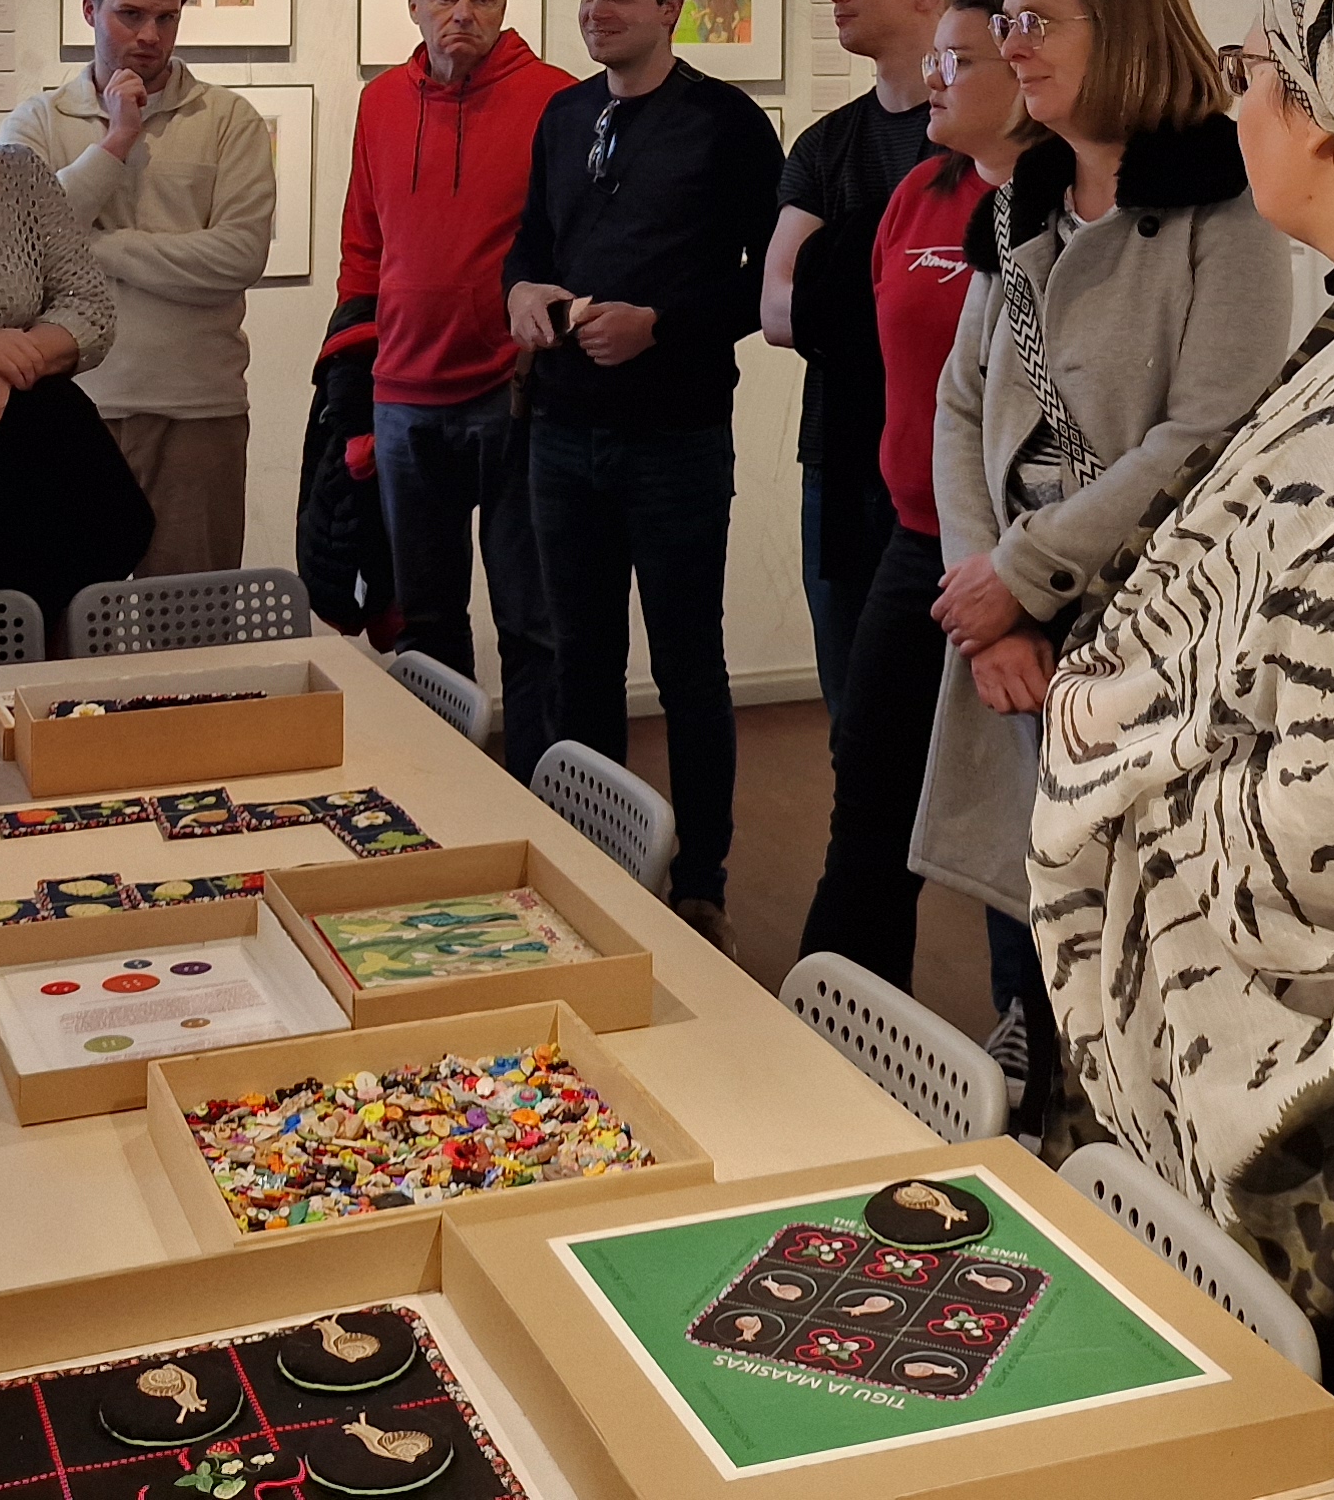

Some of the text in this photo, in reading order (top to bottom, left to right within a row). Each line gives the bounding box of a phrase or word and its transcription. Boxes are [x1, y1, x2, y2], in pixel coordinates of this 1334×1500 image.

[991, 1248, 1029, 1262] SNAIL
[713, 1354, 906, 1410] TIGU JA MAASIKAS
